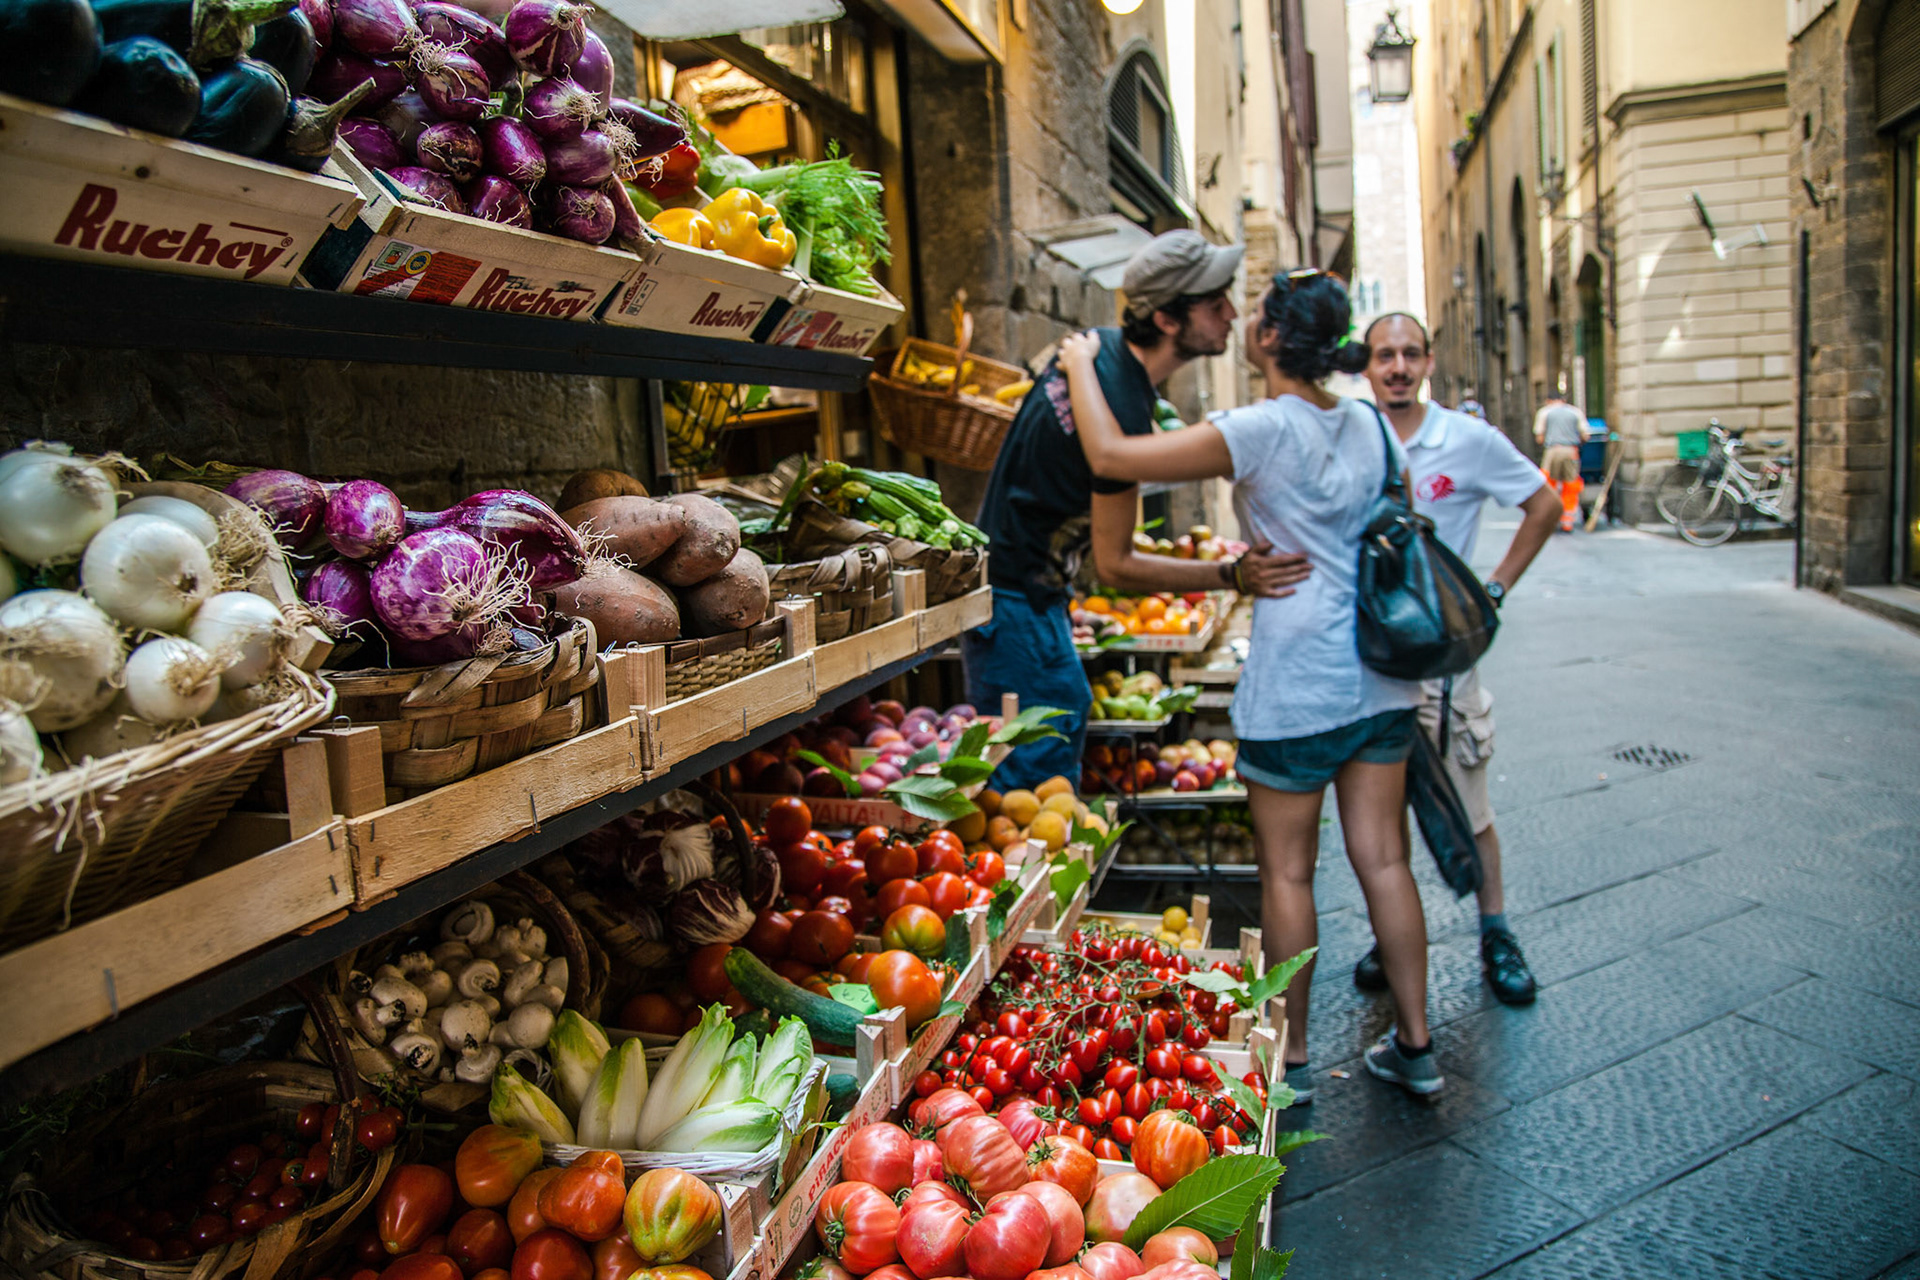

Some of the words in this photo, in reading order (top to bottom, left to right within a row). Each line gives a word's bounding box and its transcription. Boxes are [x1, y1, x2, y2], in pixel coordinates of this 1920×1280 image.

[54, 183, 287, 279] Ruchey
[467, 267, 592, 320] Ruchey
[689, 292, 761, 331] Ruchey
